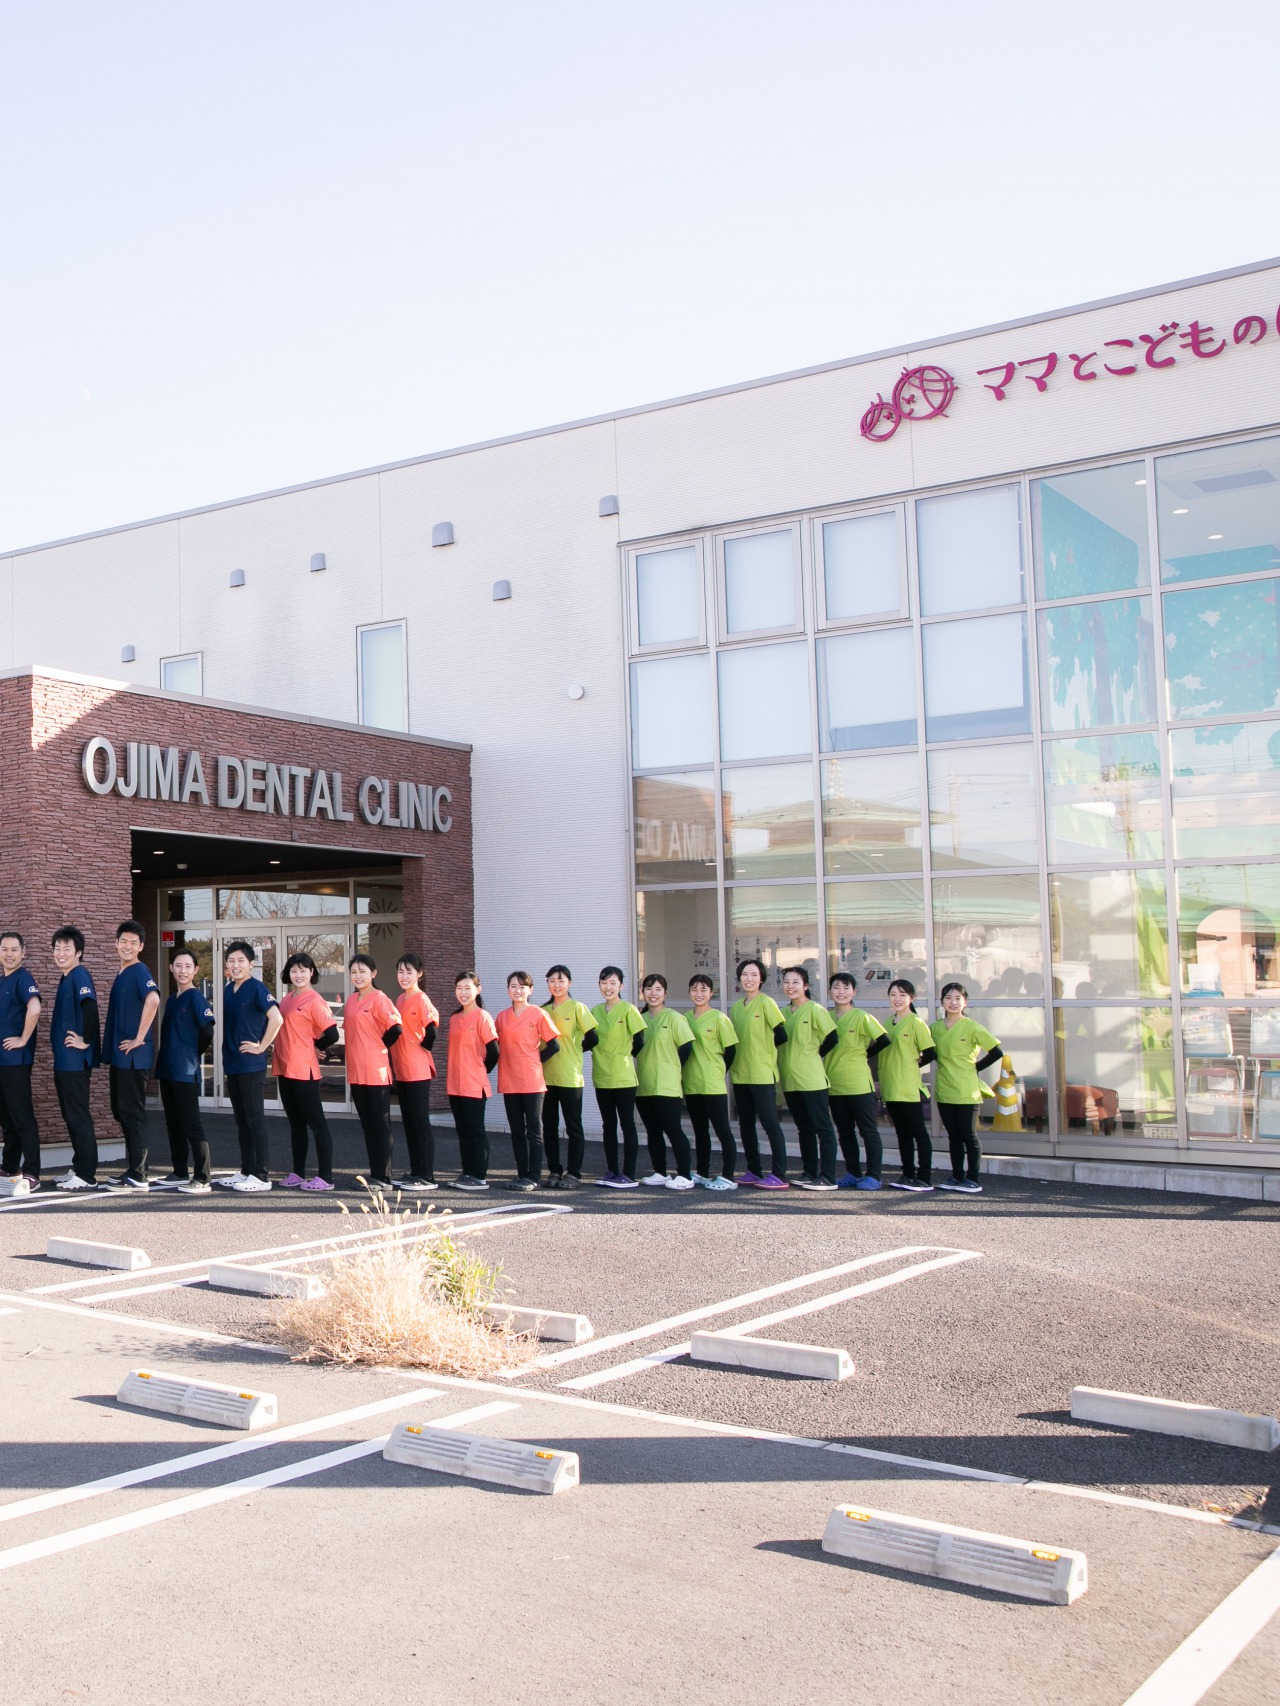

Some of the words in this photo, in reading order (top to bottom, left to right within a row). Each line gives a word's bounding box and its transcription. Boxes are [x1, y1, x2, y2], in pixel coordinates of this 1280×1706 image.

[977, 303, 1280, 401] ママとこどもの
[81, 736, 210, 805] OJIMA
[215, 755, 354, 822] DENTAL
[359, 775, 453, 833] CLINIC
